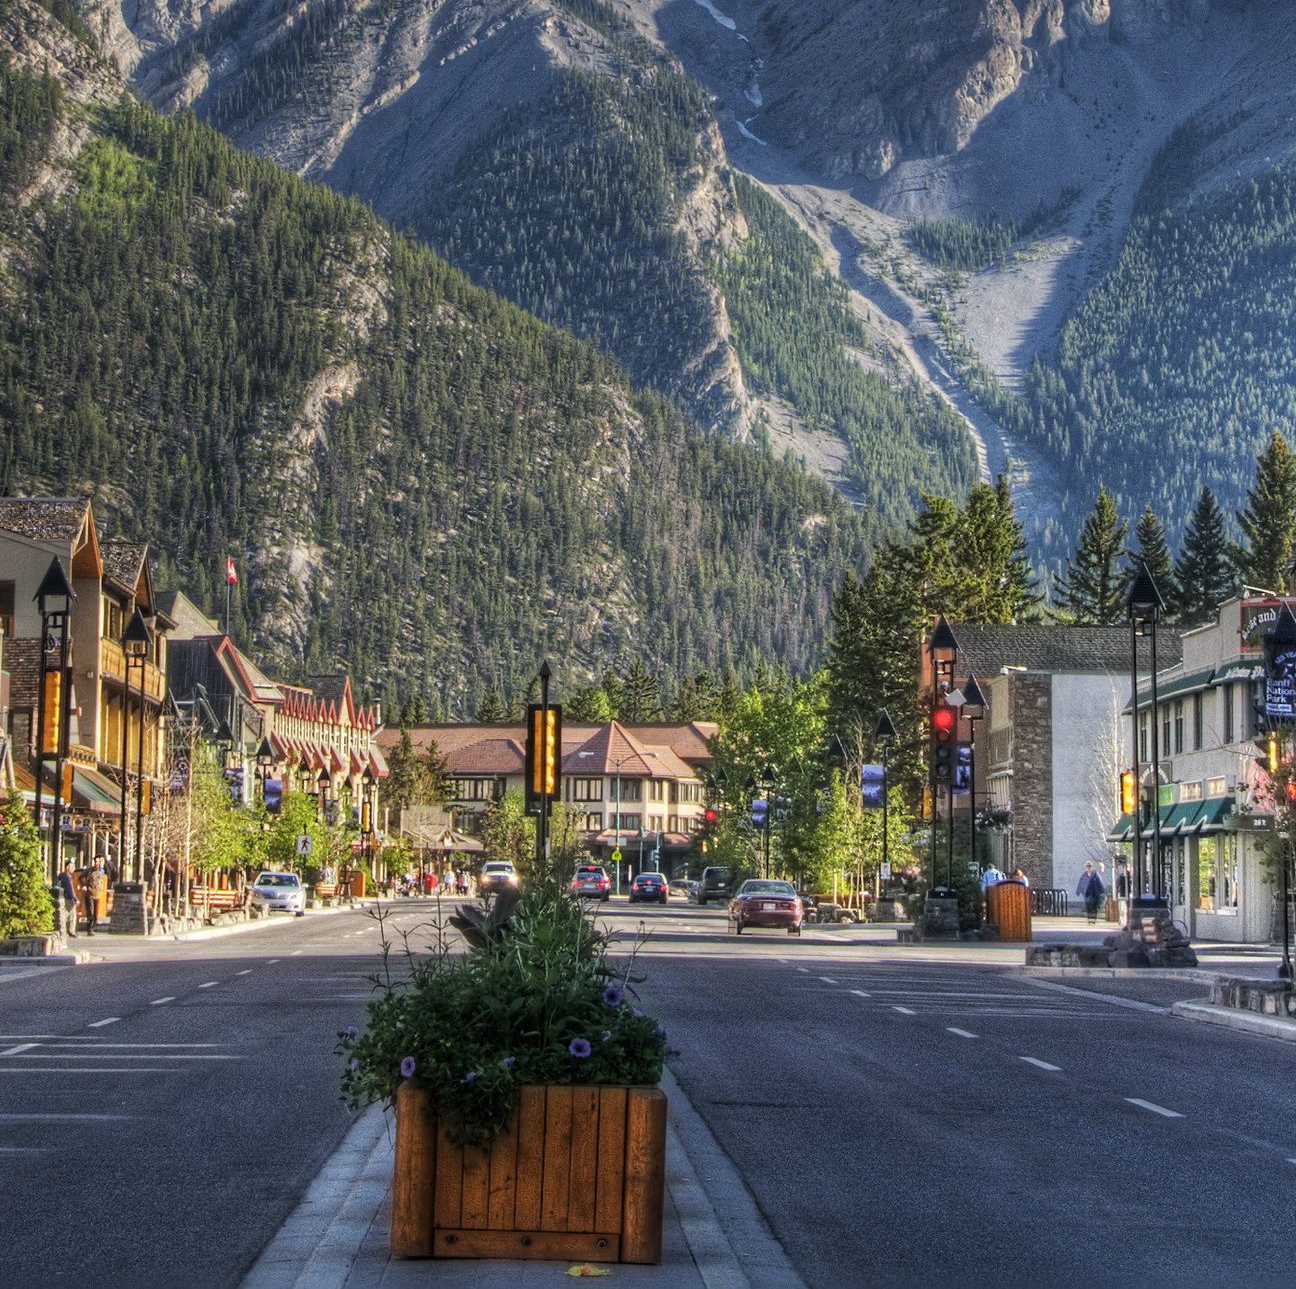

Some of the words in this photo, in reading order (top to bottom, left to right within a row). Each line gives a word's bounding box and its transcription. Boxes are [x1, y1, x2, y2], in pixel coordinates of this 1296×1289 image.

[1258, 609, 1276, 624] and
[1266, 678, 1290, 687] Banff
[1266, 694, 1287, 703] Park
